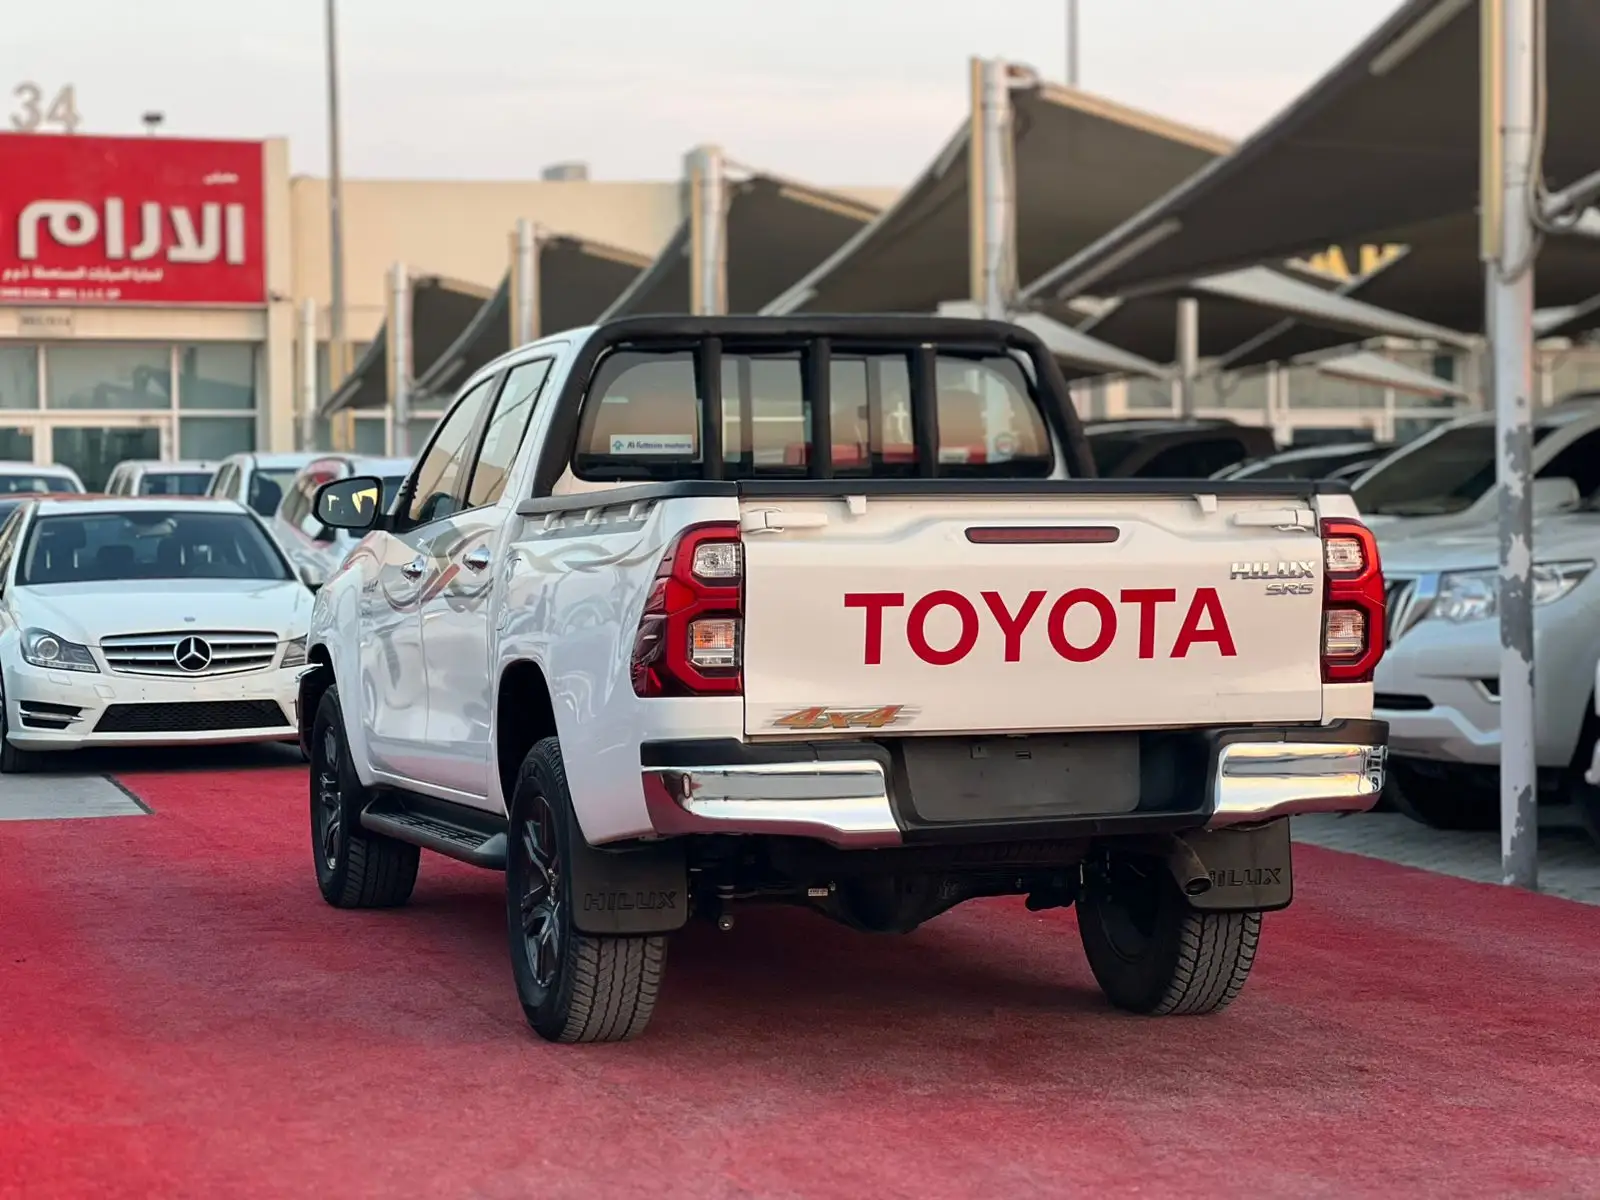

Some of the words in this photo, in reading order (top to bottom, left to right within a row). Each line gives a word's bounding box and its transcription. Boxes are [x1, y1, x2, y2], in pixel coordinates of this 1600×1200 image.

[10, 81, 83, 134] 34
[1230, 560, 1315, 580] HILUX
[844, 587, 1238, 666] TOYOTA
[772, 704, 905, 730] 4x4
[583, 890, 678, 911] HILUX
